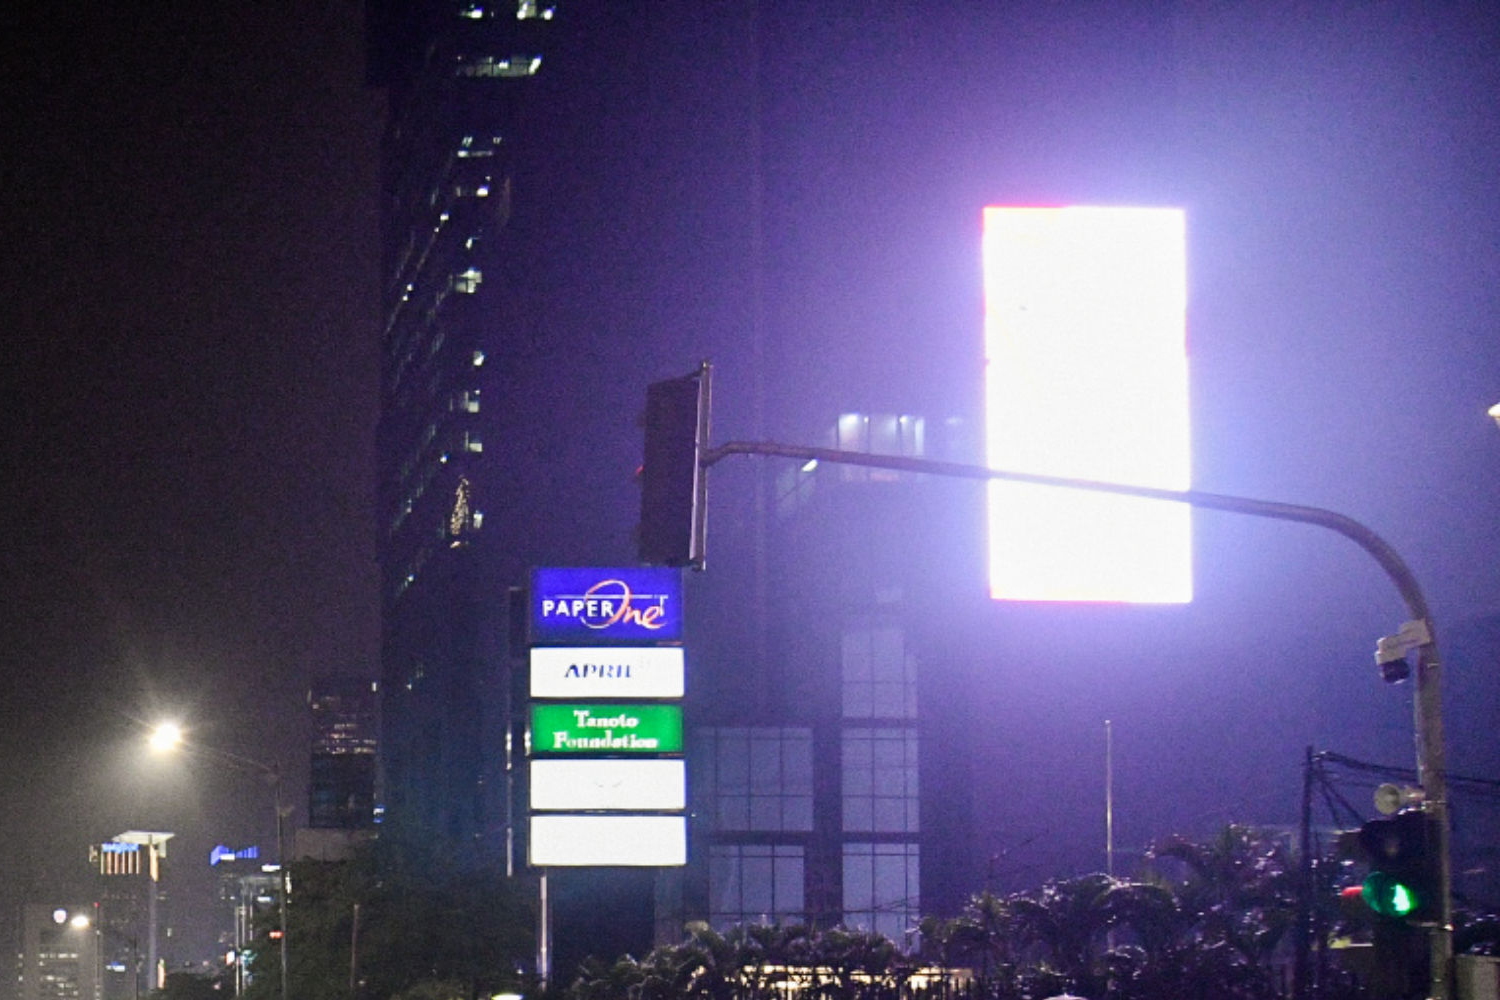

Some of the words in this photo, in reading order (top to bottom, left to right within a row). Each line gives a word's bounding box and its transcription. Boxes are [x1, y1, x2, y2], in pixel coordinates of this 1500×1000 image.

[542, 599, 614, 617] PAPER
[564, 663, 631, 678] APRIL
[573, 709, 639, 728] Tanoto
[553, 729, 658, 749] Foundation
